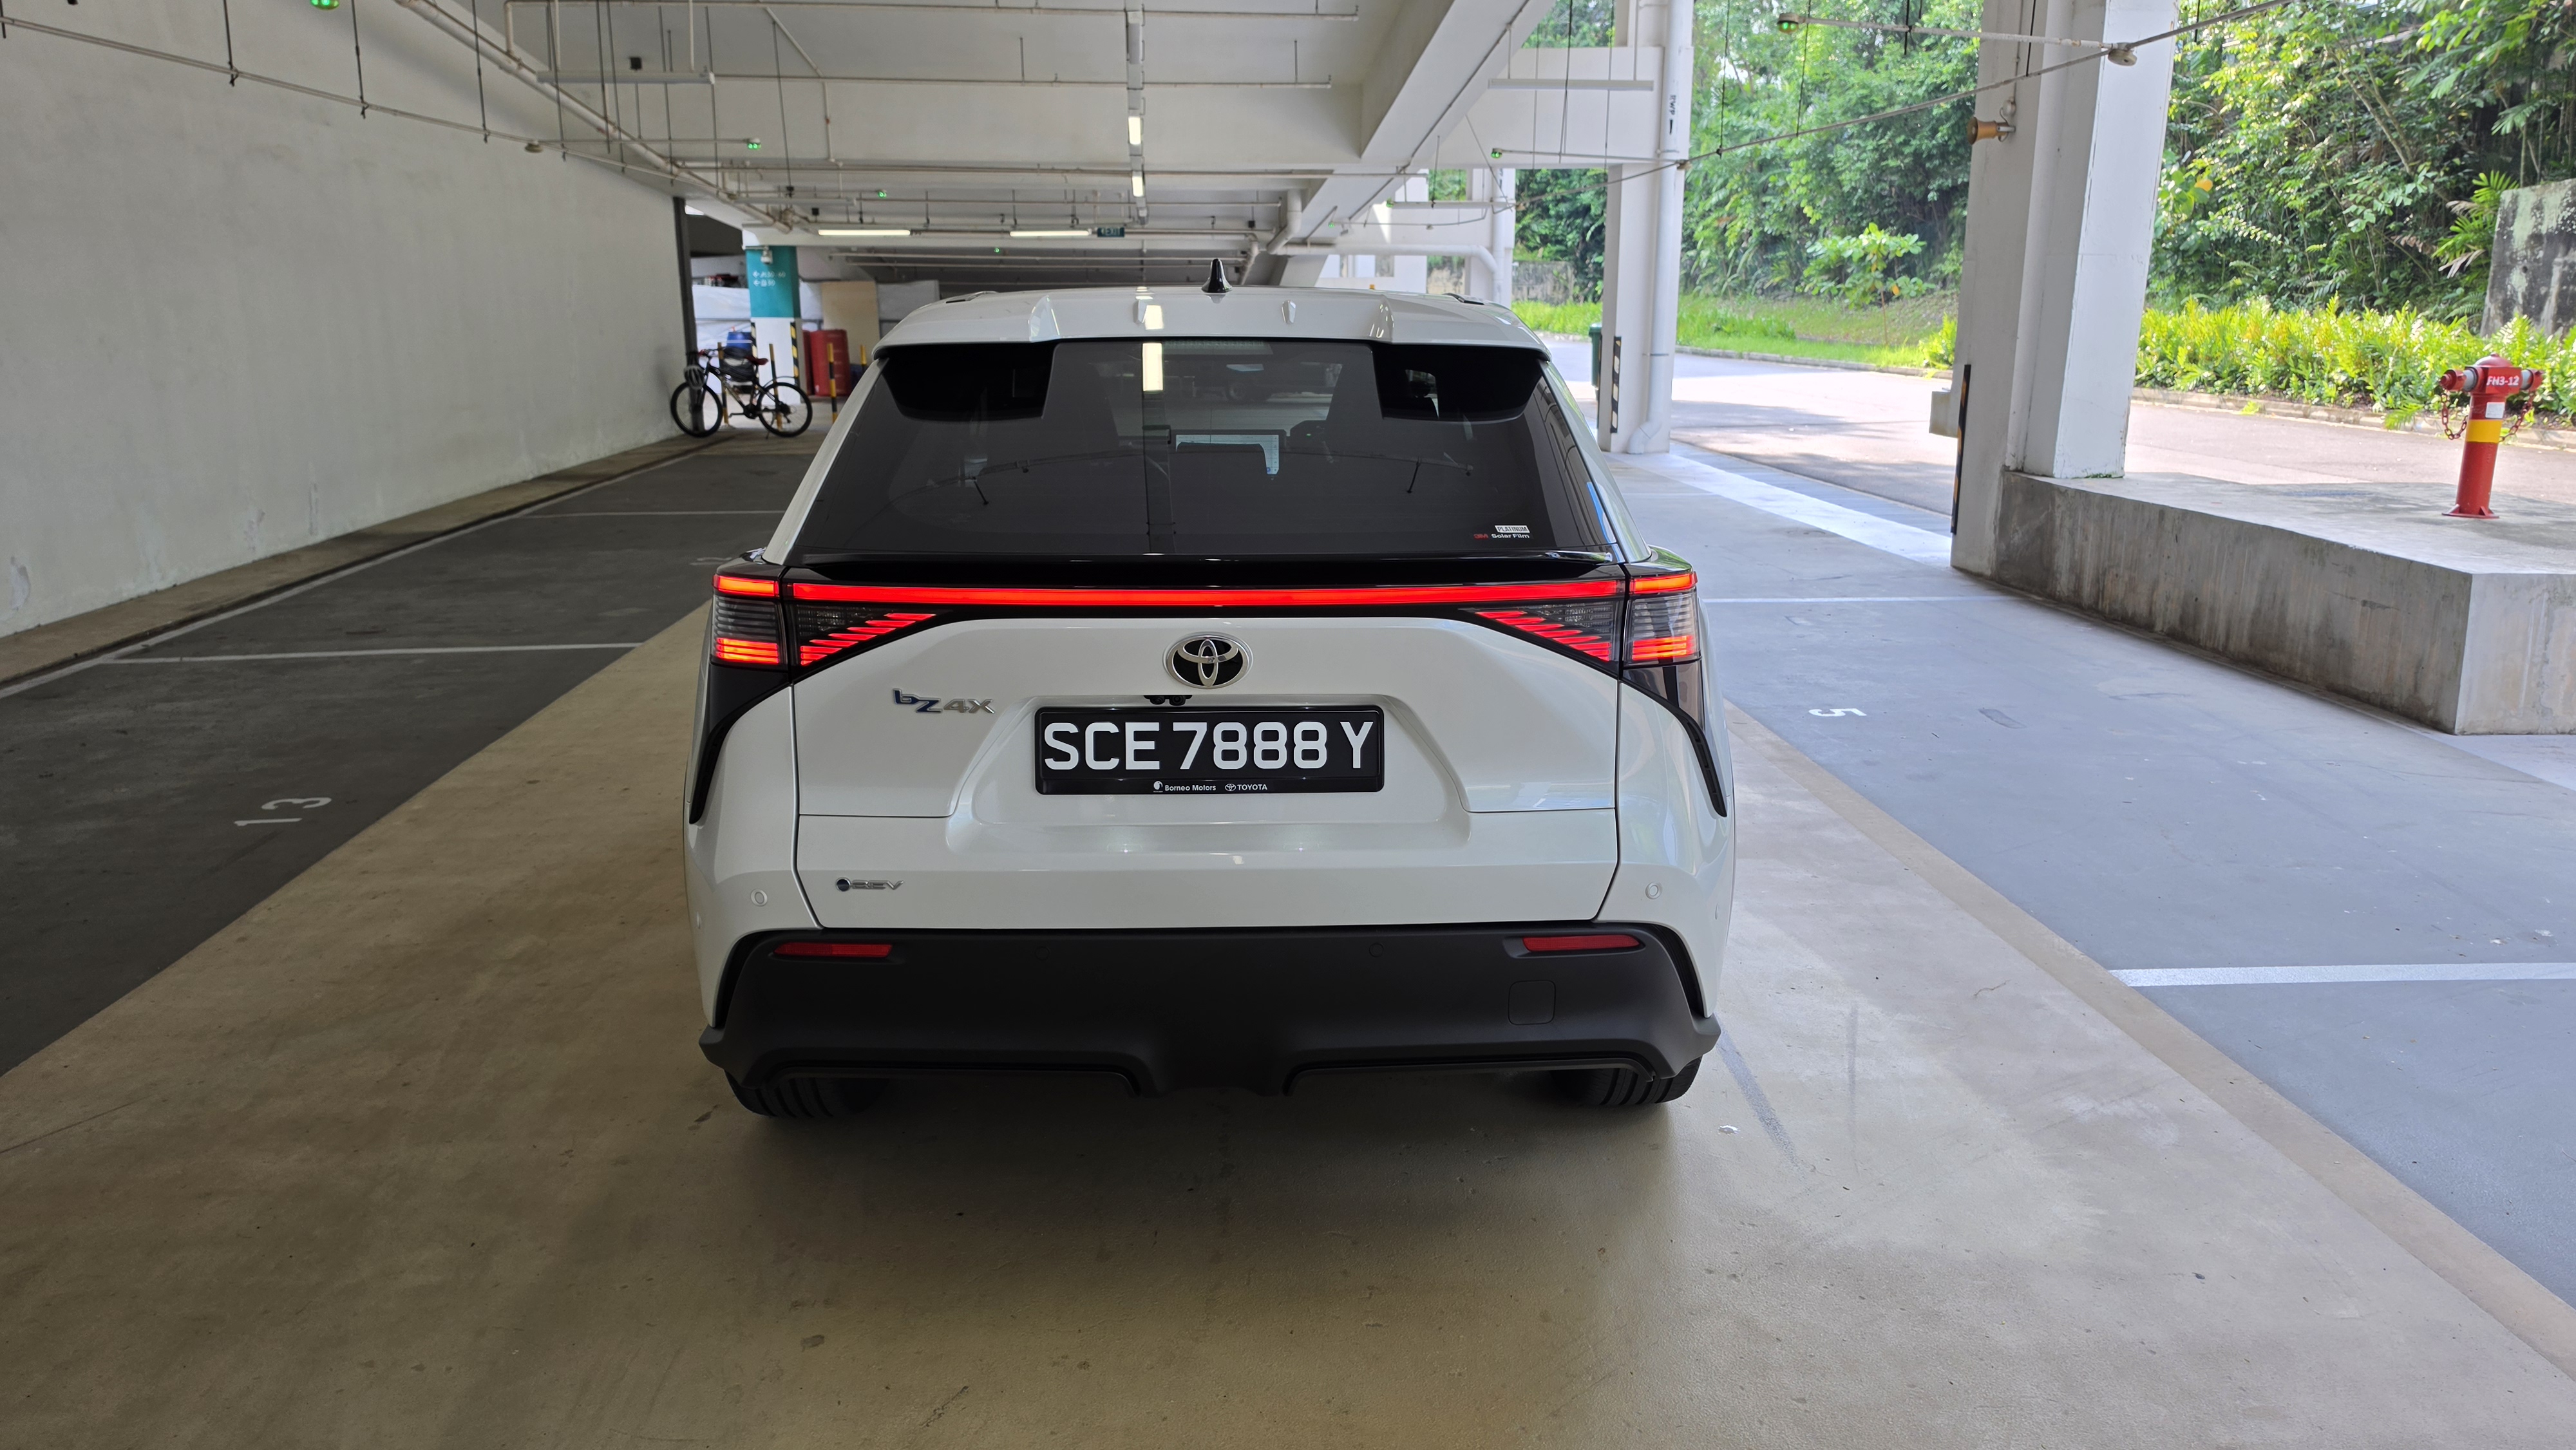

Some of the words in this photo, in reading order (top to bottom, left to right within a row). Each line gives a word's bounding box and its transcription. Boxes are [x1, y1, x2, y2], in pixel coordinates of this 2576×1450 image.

[2486, 375, 2519, 386] FH3-12
[893, 688, 995, 714] bZ4X
[1808, 708, 1867, 717] 5
[1043, 722, 1160, 771] SCE
[1173, 721, 1328, 770] 7888
[1340, 720, 1374, 769] Y
[234, 797, 332, 826] 13
[851, 879, 905, 890] BEV
